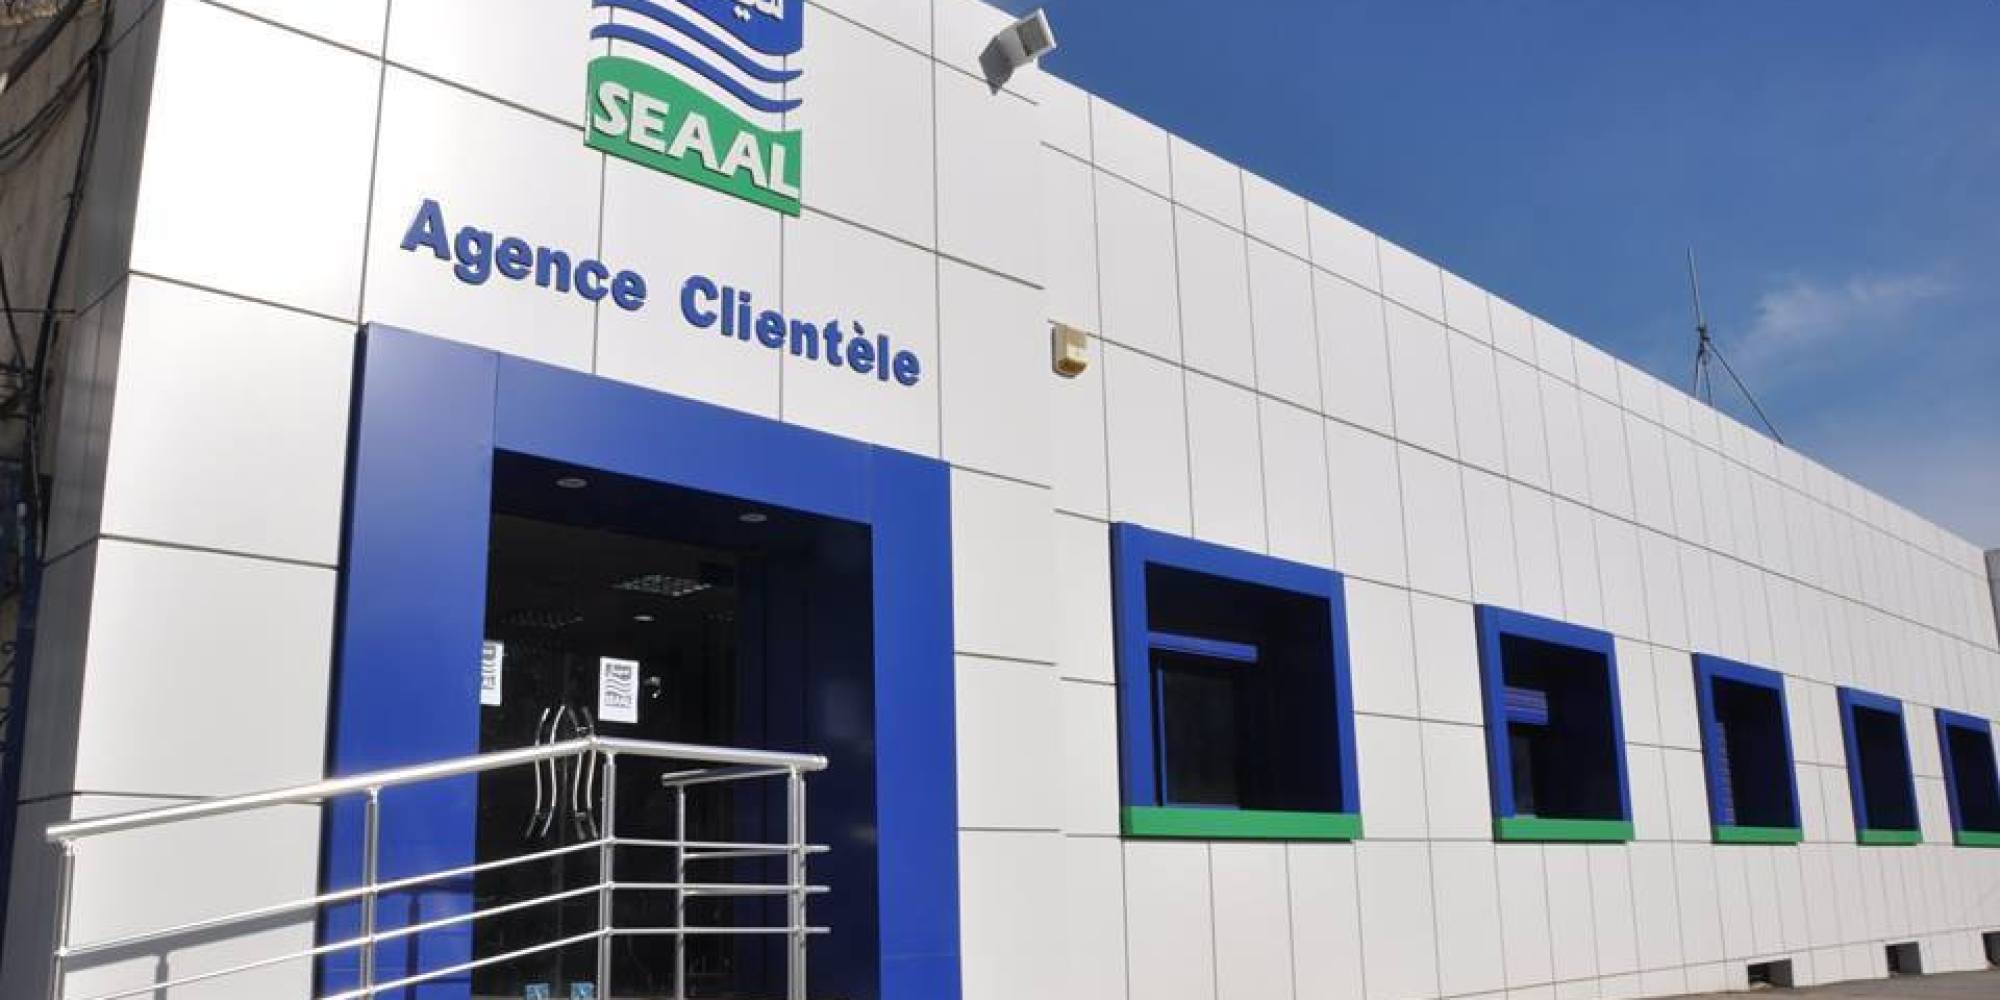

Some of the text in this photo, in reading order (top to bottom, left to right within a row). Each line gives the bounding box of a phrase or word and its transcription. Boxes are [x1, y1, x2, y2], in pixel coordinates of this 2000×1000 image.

[593, 80, 800, 198] SEAAL
[401, 198, 922, 387] Agence Clientèle
